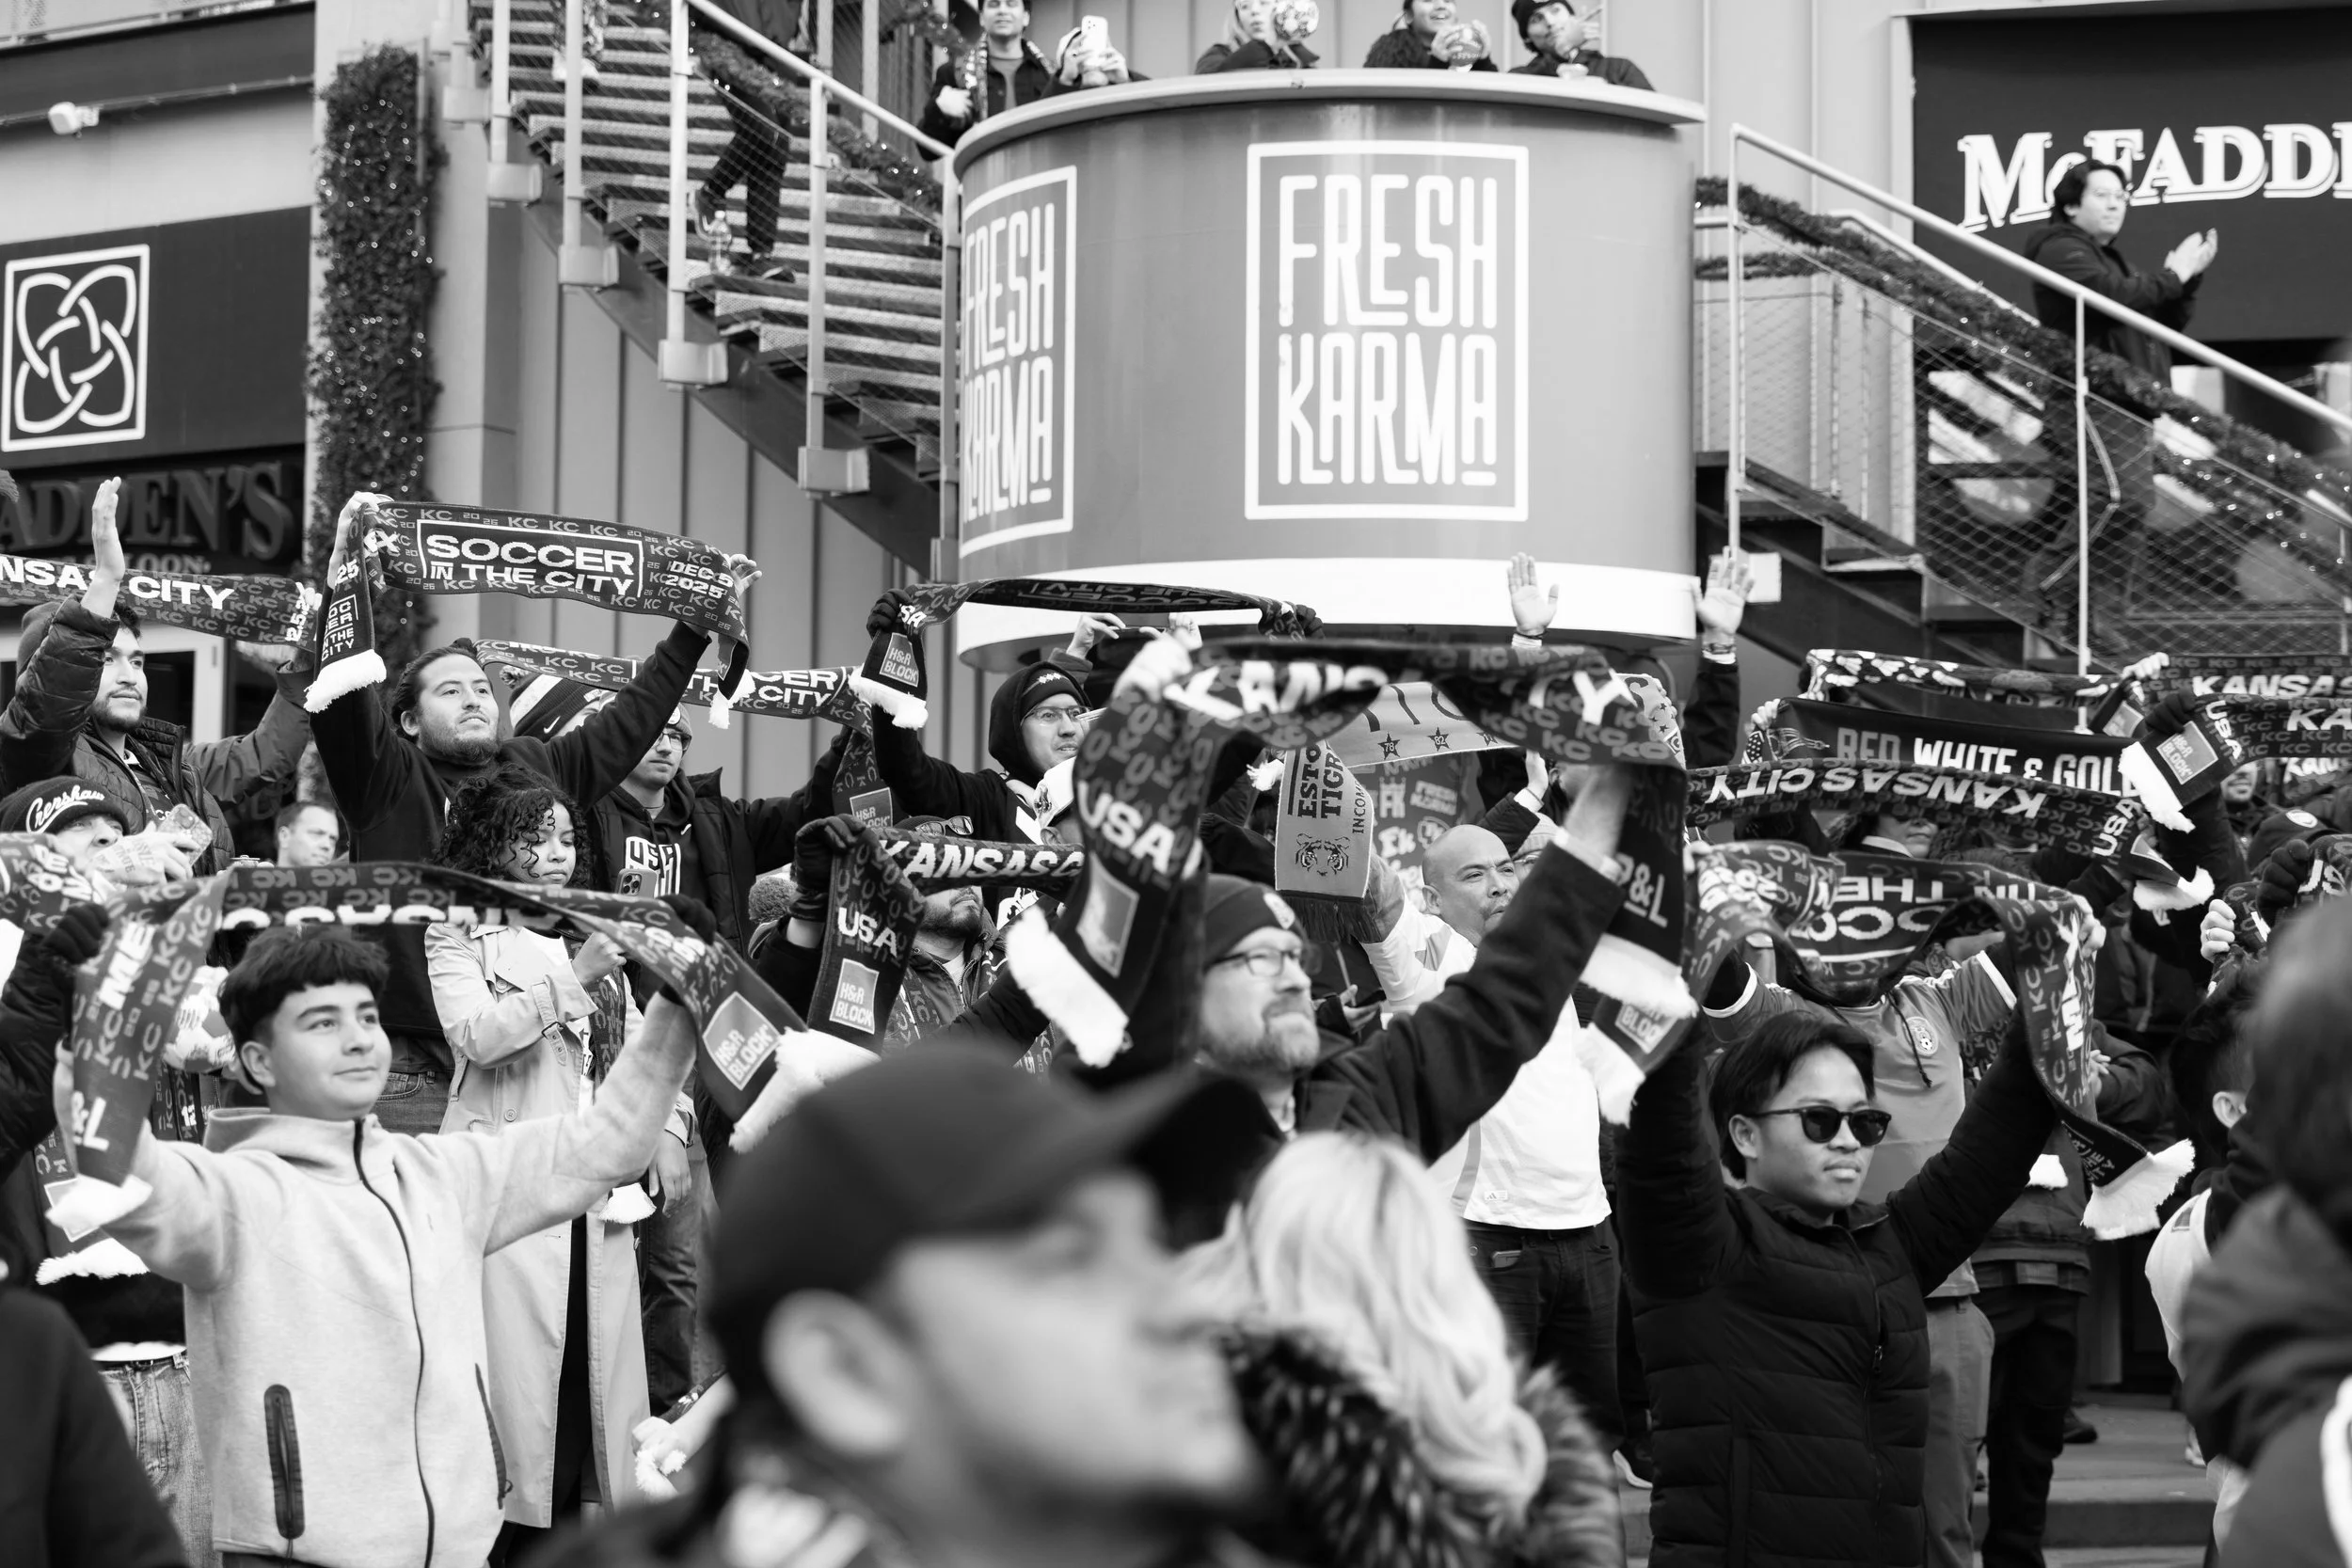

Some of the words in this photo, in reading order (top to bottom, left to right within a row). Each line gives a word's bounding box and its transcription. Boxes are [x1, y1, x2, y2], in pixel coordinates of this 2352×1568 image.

[1279, 174, 1498, 329] FRESH
[964, 203, 1055, 376] FRESH
[1278, 332, 1498, 486] KARMA
[421, 509, 452, 520] KC
[507, 517, 539, 529] KC
[548, 520, 580, 533] KC
[590, 524, 618, 537] KC
[650, 545, 678, 558] KC
[667, 536, 695, 549] KC
[426, 534, 634, 576] SOCCER
[687, 551, 713, 565] KC
[430, 562, 453, 580] IN
[461, 563, 536, 584] THE
[545, 570, 634, 595] CITY
[670, 561, 714, 578] DEC
[0, 556, 97, 591] NSA
[128, 576, 235, 610] CITY
[658, 586, 681, 599] KC
[665, 575, 723, 598] 2025
[611, 594, 637, 608] KC
[644, 598, 661, 610] KC
[668, 601, 696, 616] KC
[690, 593, 718, 610] KC
[192, 616, 218, 630] KC
[225, 624, 250, 637] KC
[546, 657, 578, 668] KC
[591, 661, 624, 674] KC
[889, 647, 912, 666] H&R
[569, 671, 601, 682] KC
[884, 660, 918, 682] BLOCK
[739, 697, 767, 708] KC
[758, 685, 833, 707] CITY
[1435, 735, 1446, 745] 82
[2205, 700, 2243, 759] USA
[2301, 730, 2331, 740] KC
[1384, 742, 1394, 752] 78
[2172, 733, 2195, 757] H&R
[2279, 743, 2311, 753] KC
[1914, 737, 2017, 774] WHITE
[2024, 758, 2043, 781] &
[2162, 741, 2193, 781] BLOCK
[1705, 768, 1816, 803] CITY
[1821, 768, 2047, 819] KANSAS
[856, 806, 876, 821] H&R
[1077, 781, 1174, 876] USA
[2092, 798, 2142, 857] USA
[152, 920, 186, 967] KC
[837, 907, 898, 958] USA
[157, 956, 193, 1006] KC
[840, 983, 865, 1005] H&R
[835, 1000, 874, 1027] BLOCK
[94, 1010, 123, 1066] KC
[715, 1029, 746, 1066] H&R
[134, 1022, 162, 1081] KC
[726, 1023, 774, 1080] BLOCK
